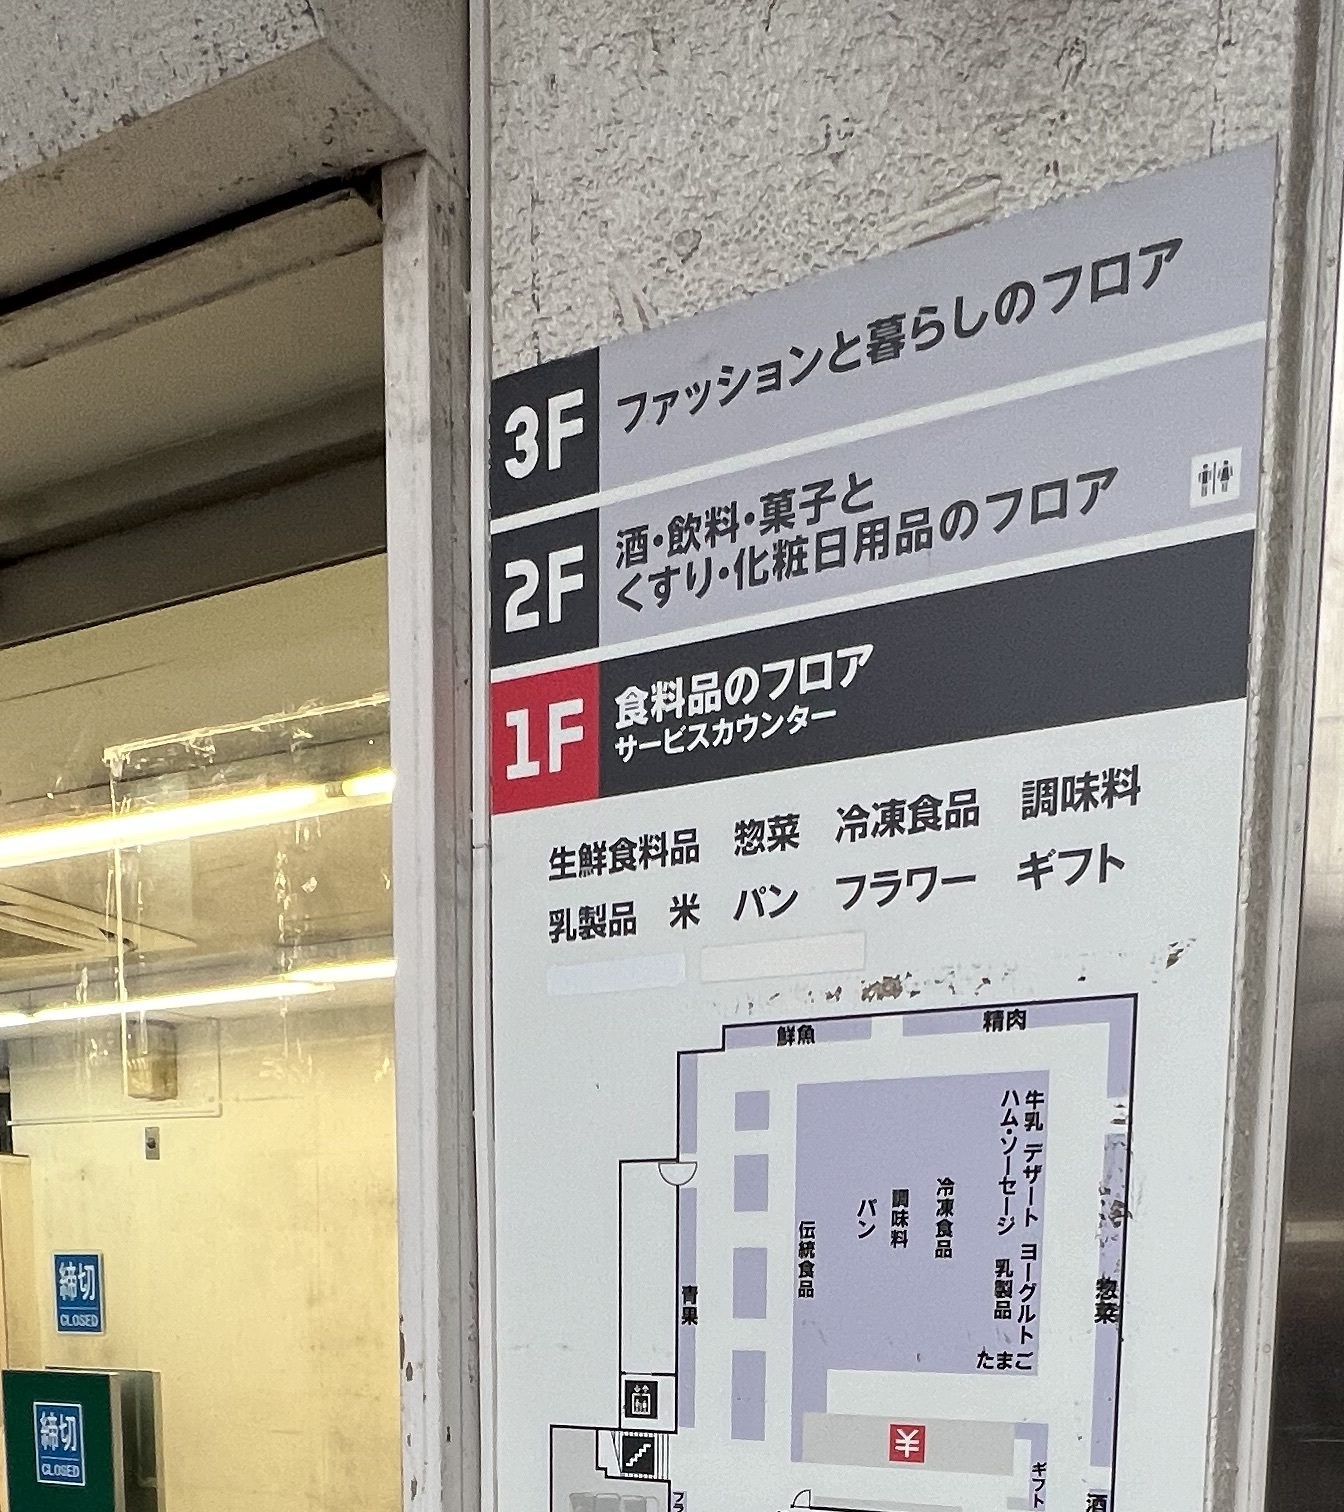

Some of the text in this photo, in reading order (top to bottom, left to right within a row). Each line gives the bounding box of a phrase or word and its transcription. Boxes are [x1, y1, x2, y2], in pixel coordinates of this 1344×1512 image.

[504, 238, 1183, 480] 3F ファッションと暮らしのフロア
[504, 472, 875, 634] 2F 酒・飲料・菓子と
[617, 465, 1119, 614] くすり・化粧日用品のフロア
[505, 643, 875, 780] 1F 食料品のフロア
[615, 708, 837, 764] サービスカウンター
[548, 764, 1142, 882] 生鮮食料品 惣菜 冷凍食品 調味料
[548, 842, 1126, 944] 乳製品 米 パン フラワー ギフト
[776, 1024, 816, 1047] 鮮魚
[983, 1009, 1027, 1034] 精肉
[997, 1089, 1019, 1236] ハム・ソーセージ
[856, 1198, 877, 1239] パン
[890, 1188, 909, 1249] 調味料
[935, 1177, 955, 1260] 冷凍食品
[1017, 1089, 1045, 1345] 牛乳 デザート ヨーグルト
[59, 1261, 96, 1301] 締切
[797, 1220, 816, 1299] 伝統食品
[993, 1257, 1014, 1321] 乳製品
[59, 1313, 99, 1329] CLOSED
[681, 1284, 698, 1326] 青果
[976, 1350, 1033, 1371] たまご
[39, 1411, 77, 1451] 締切
[41, 1462, 80, 1479] CLOSED
[1032, 1461, 1047, 1509] ギフト
